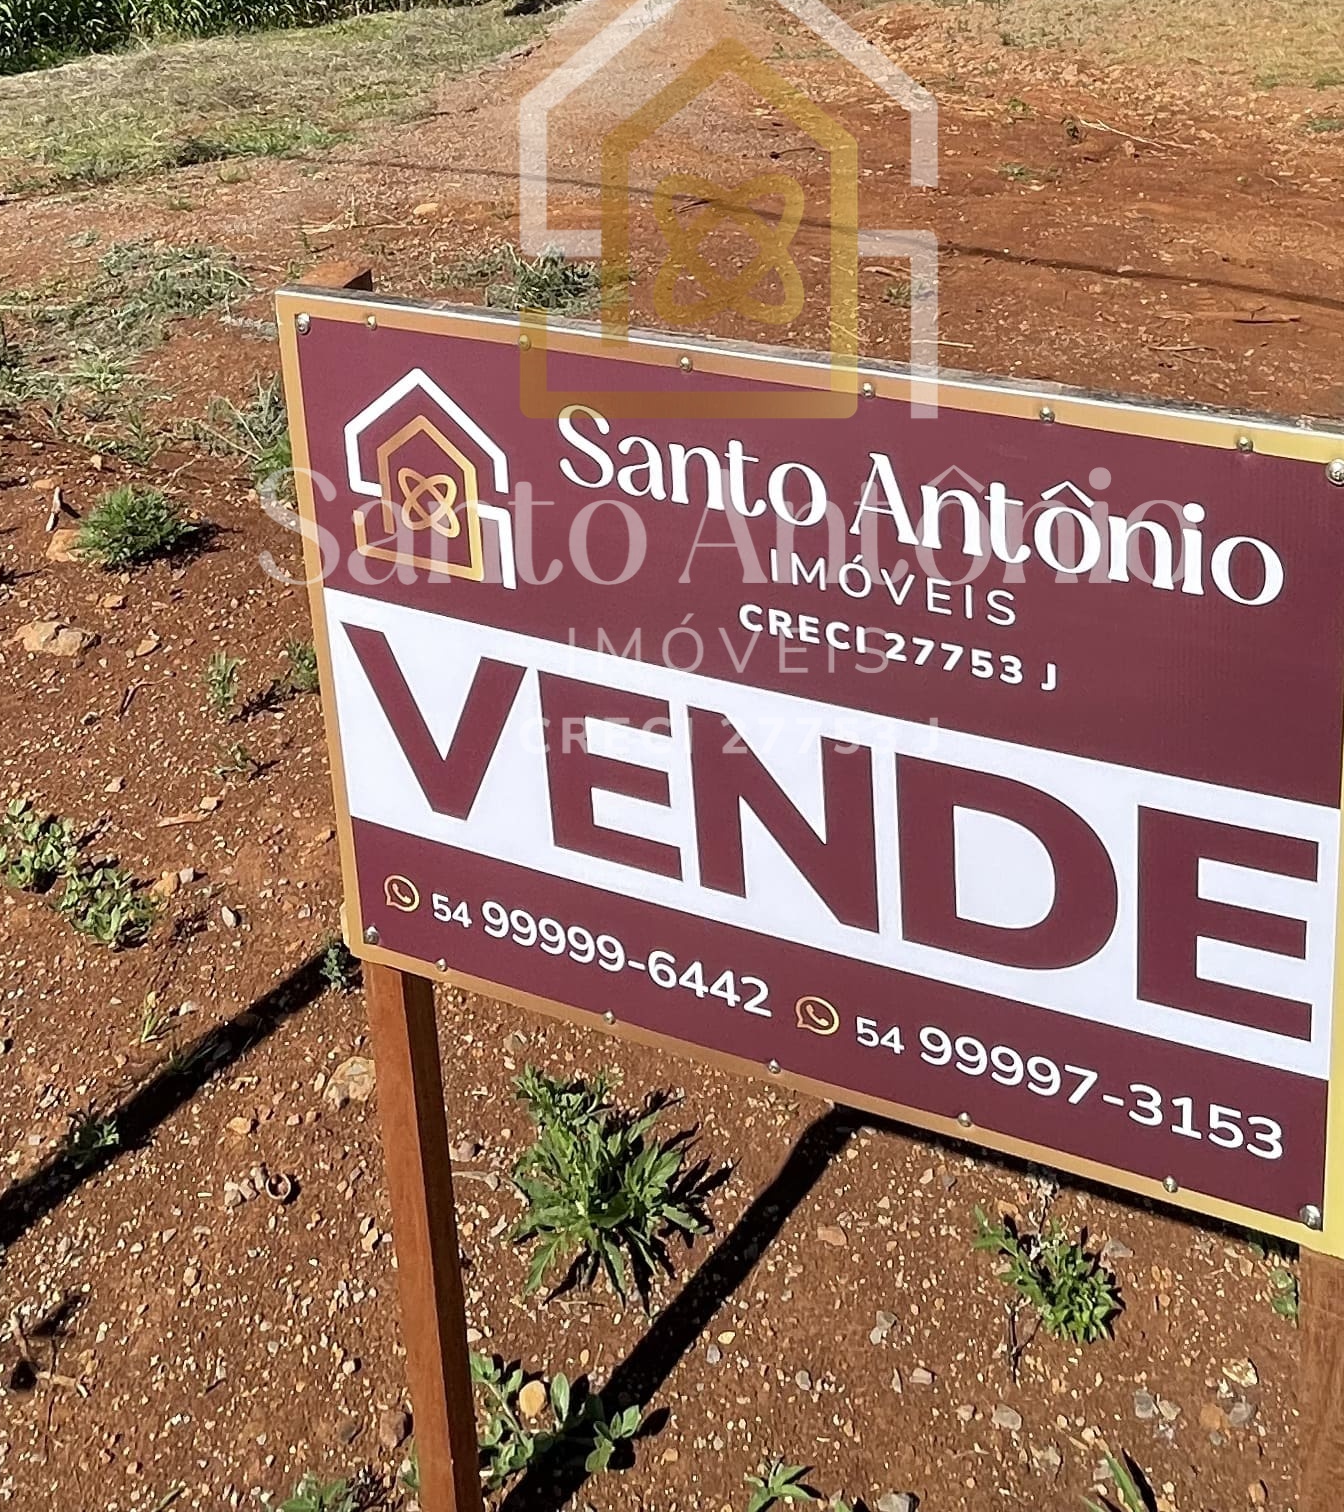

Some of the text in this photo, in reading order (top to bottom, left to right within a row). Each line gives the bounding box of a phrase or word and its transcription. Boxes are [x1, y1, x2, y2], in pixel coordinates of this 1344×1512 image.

[557, 403, 1286, 608] Santo Antônio
[738, 603, 1058, 692] CRECI 27753 J
[769, 547, 1018, 628] IMÓVEIS
[342, 621, 1320, 1044] VENDE
[431, 892, 773, 1019] 54 99999-6442
[855, 1016, 1286, 1162] 54 99997-3153
